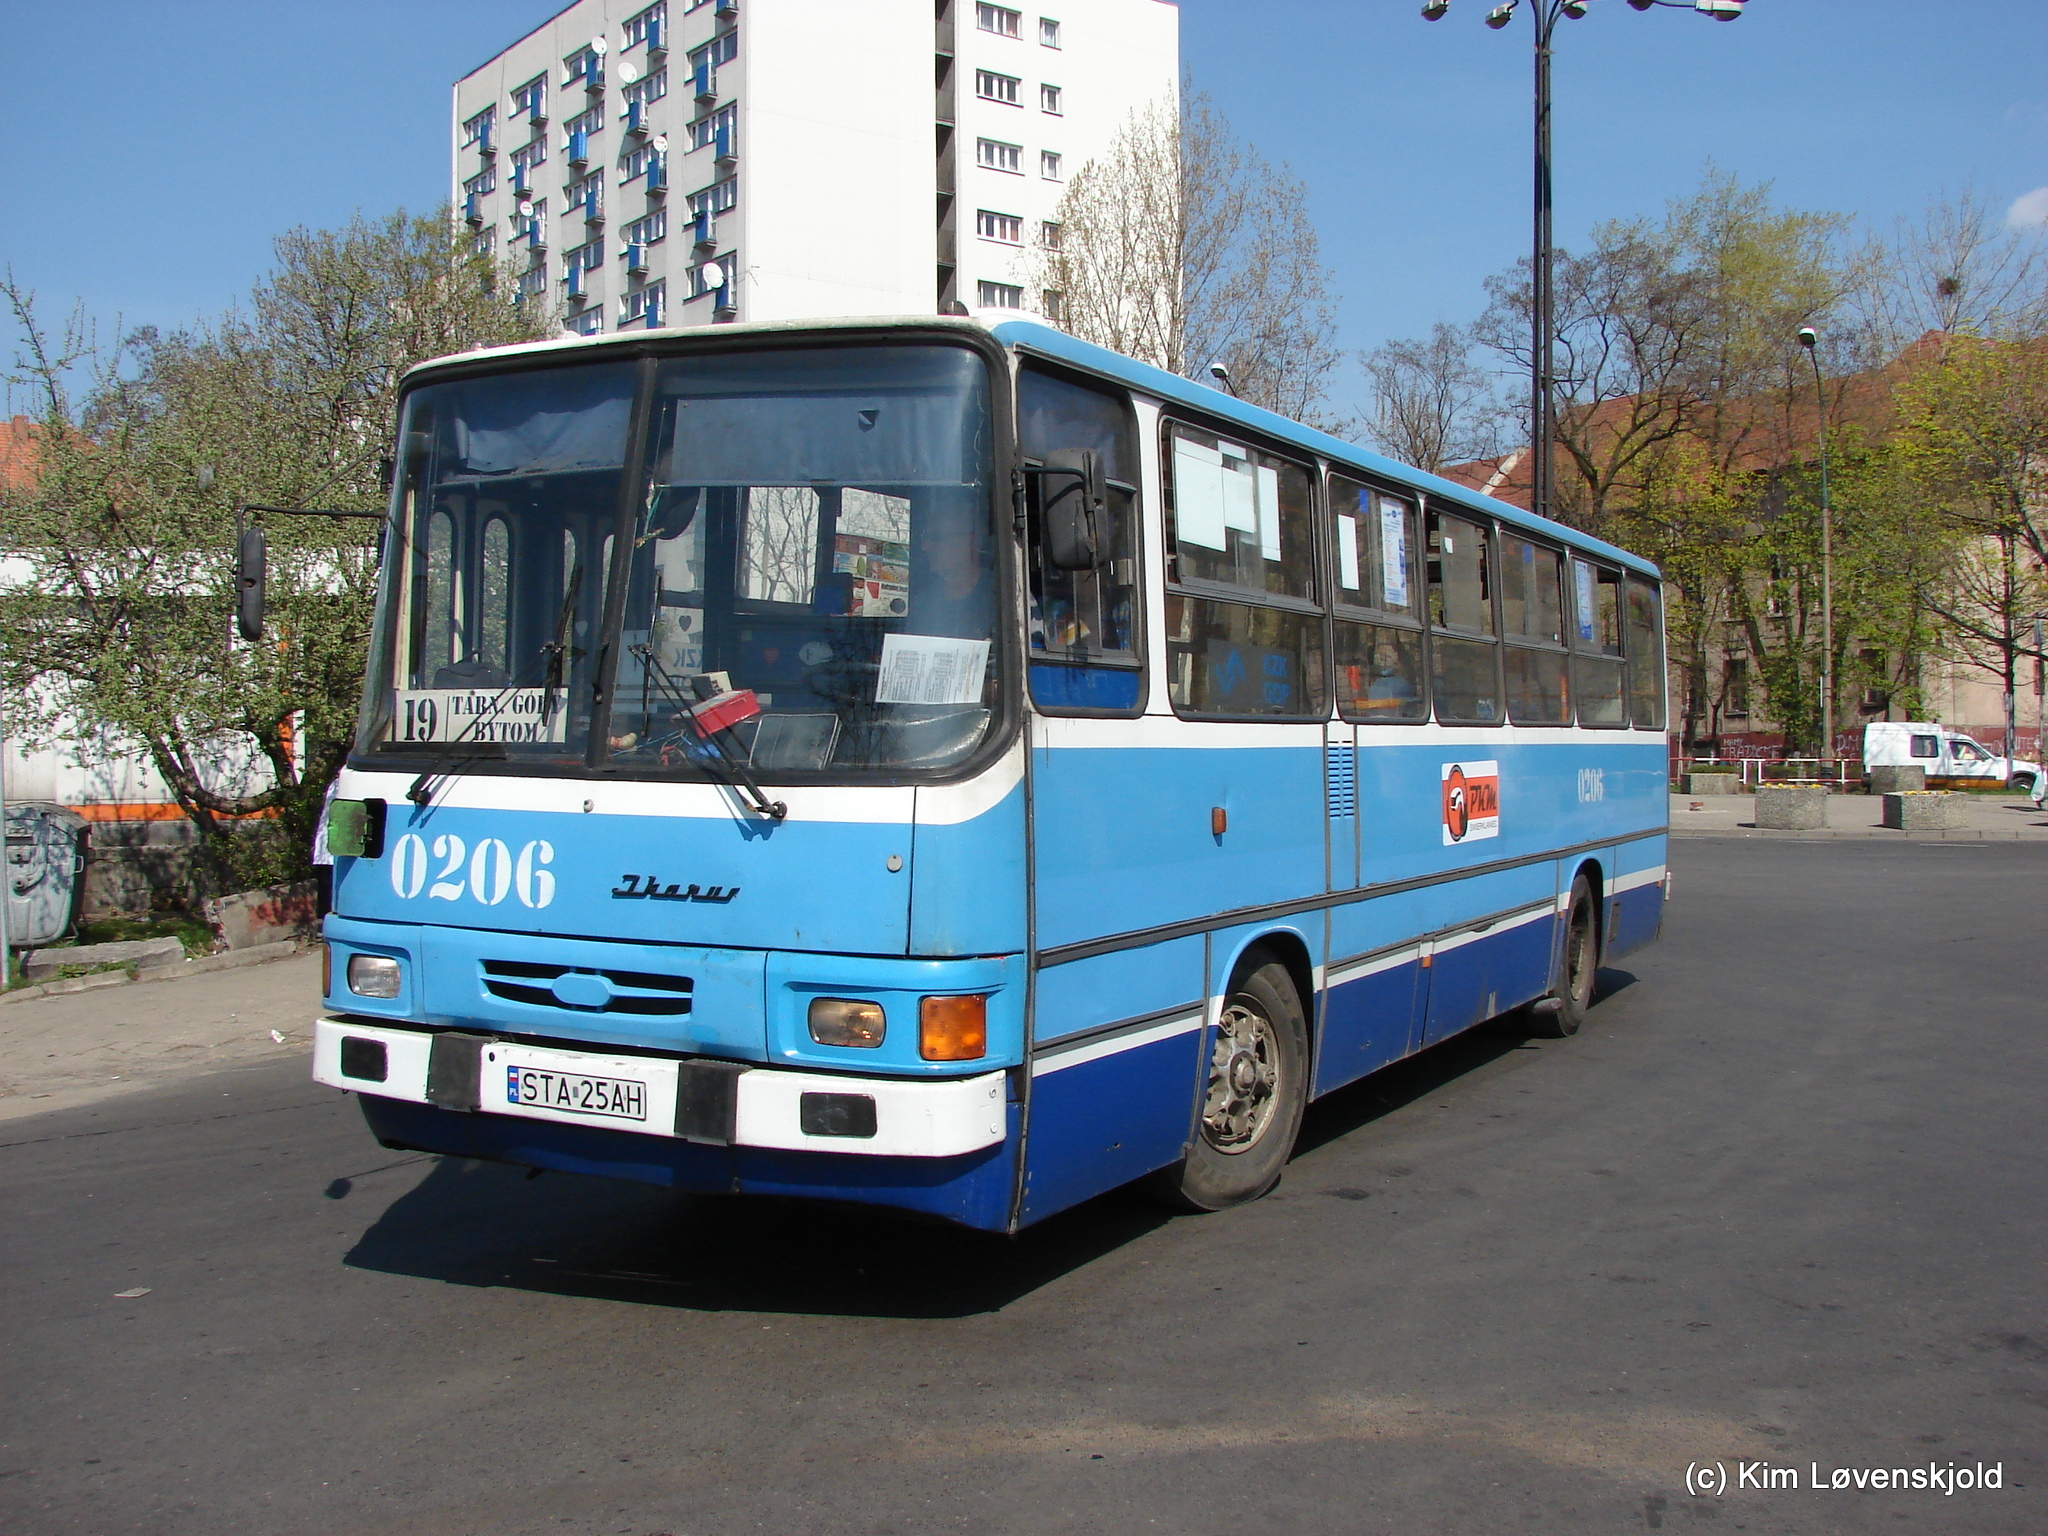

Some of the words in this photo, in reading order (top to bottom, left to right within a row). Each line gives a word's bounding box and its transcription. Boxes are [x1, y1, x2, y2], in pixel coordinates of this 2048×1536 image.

[405, 698, 437, 742] 19
[474, 721, 539, 742] BYTOM
[1577, 768, 1603, 803] 0206
[391, 833, 556, 909] 0206
[509, 1088, 518, 1096] PL
[523, 1073, 571, 1106] STA
[580, 1080, 642, 1115] 25AH
